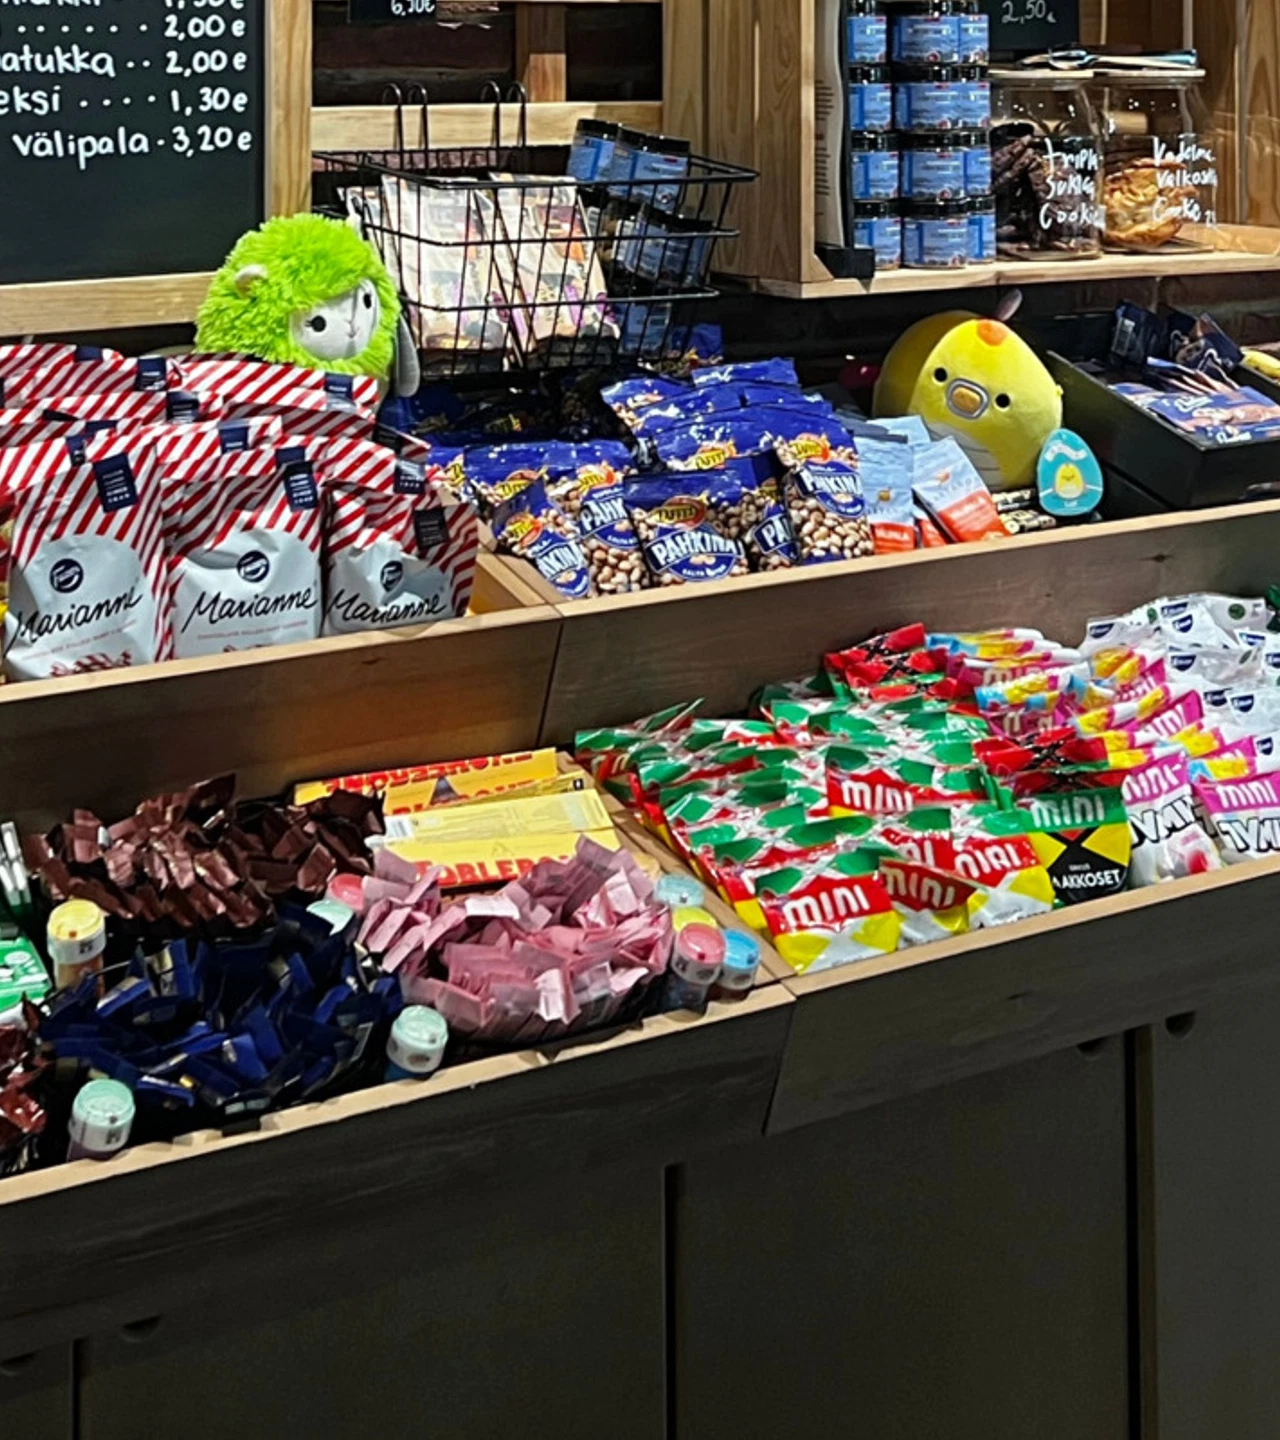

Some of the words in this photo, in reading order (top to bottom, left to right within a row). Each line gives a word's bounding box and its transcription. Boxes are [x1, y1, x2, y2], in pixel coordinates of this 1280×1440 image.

[164, 13, 246, 41] 2,00e
[165, 51, 247, 76] 2,00e
[170, 86, 248, 116] 1,30e
[12, 125, 150, 170] välipala
[172, 126, 252, 157] 3,20e
[2, 586, 143, 659] Marianne
[181, 587, 319, 633] Marianne
[324, 588, 448, 624] Marianne
[1028, 795, 1103, 829] mini
[1221, 782, 1277, 809] mini
[781, 881, 872, 930] mini
